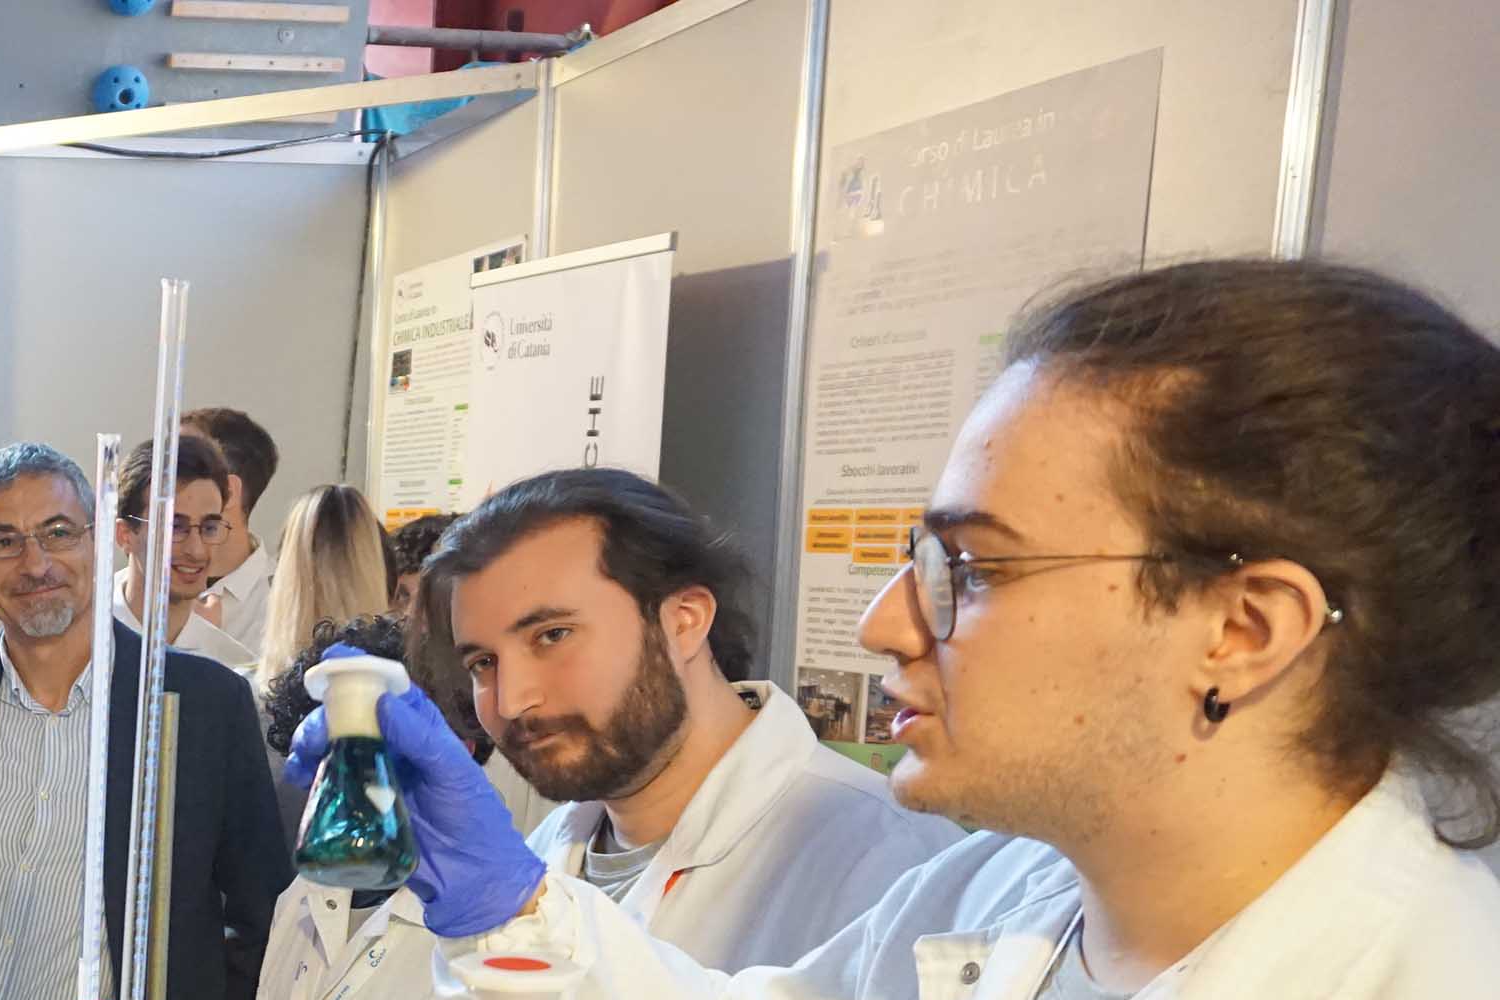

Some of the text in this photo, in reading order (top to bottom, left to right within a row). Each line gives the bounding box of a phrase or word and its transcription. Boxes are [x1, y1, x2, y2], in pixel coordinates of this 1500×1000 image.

[899, 152, 1049, 217] CHMICA
[510, 311, 554, 336] Università
[517, 338, 551, 360] Catania
